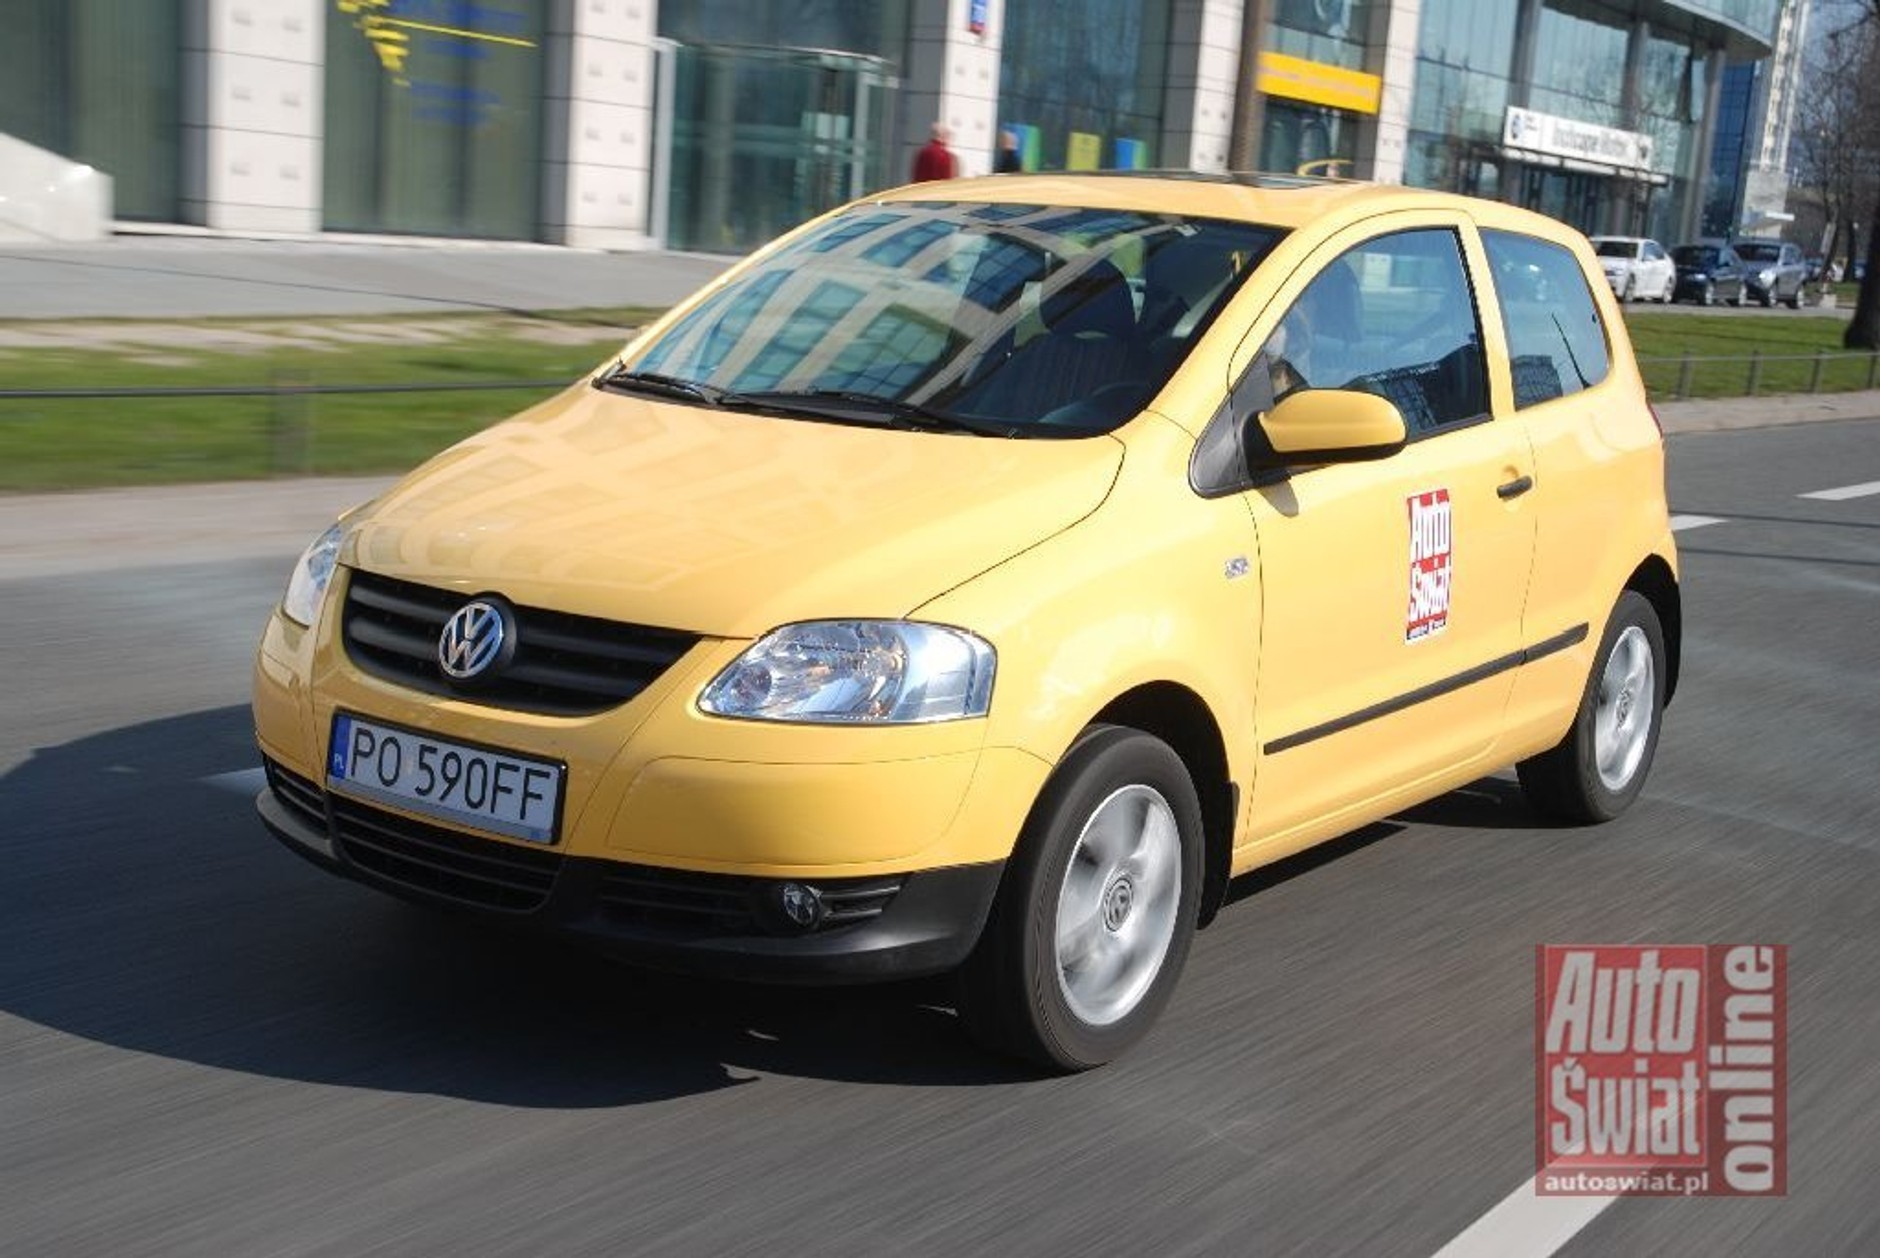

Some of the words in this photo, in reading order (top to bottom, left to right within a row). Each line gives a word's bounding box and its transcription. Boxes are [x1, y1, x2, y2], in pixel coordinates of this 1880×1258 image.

[1410, 493, 1450, 563] Auto
[439, 603, 503, 677] VW
[334, 755, 345, 771] PL
[351, 728, 400, 787] PO
[415, 744, 551, 820] 590FF
